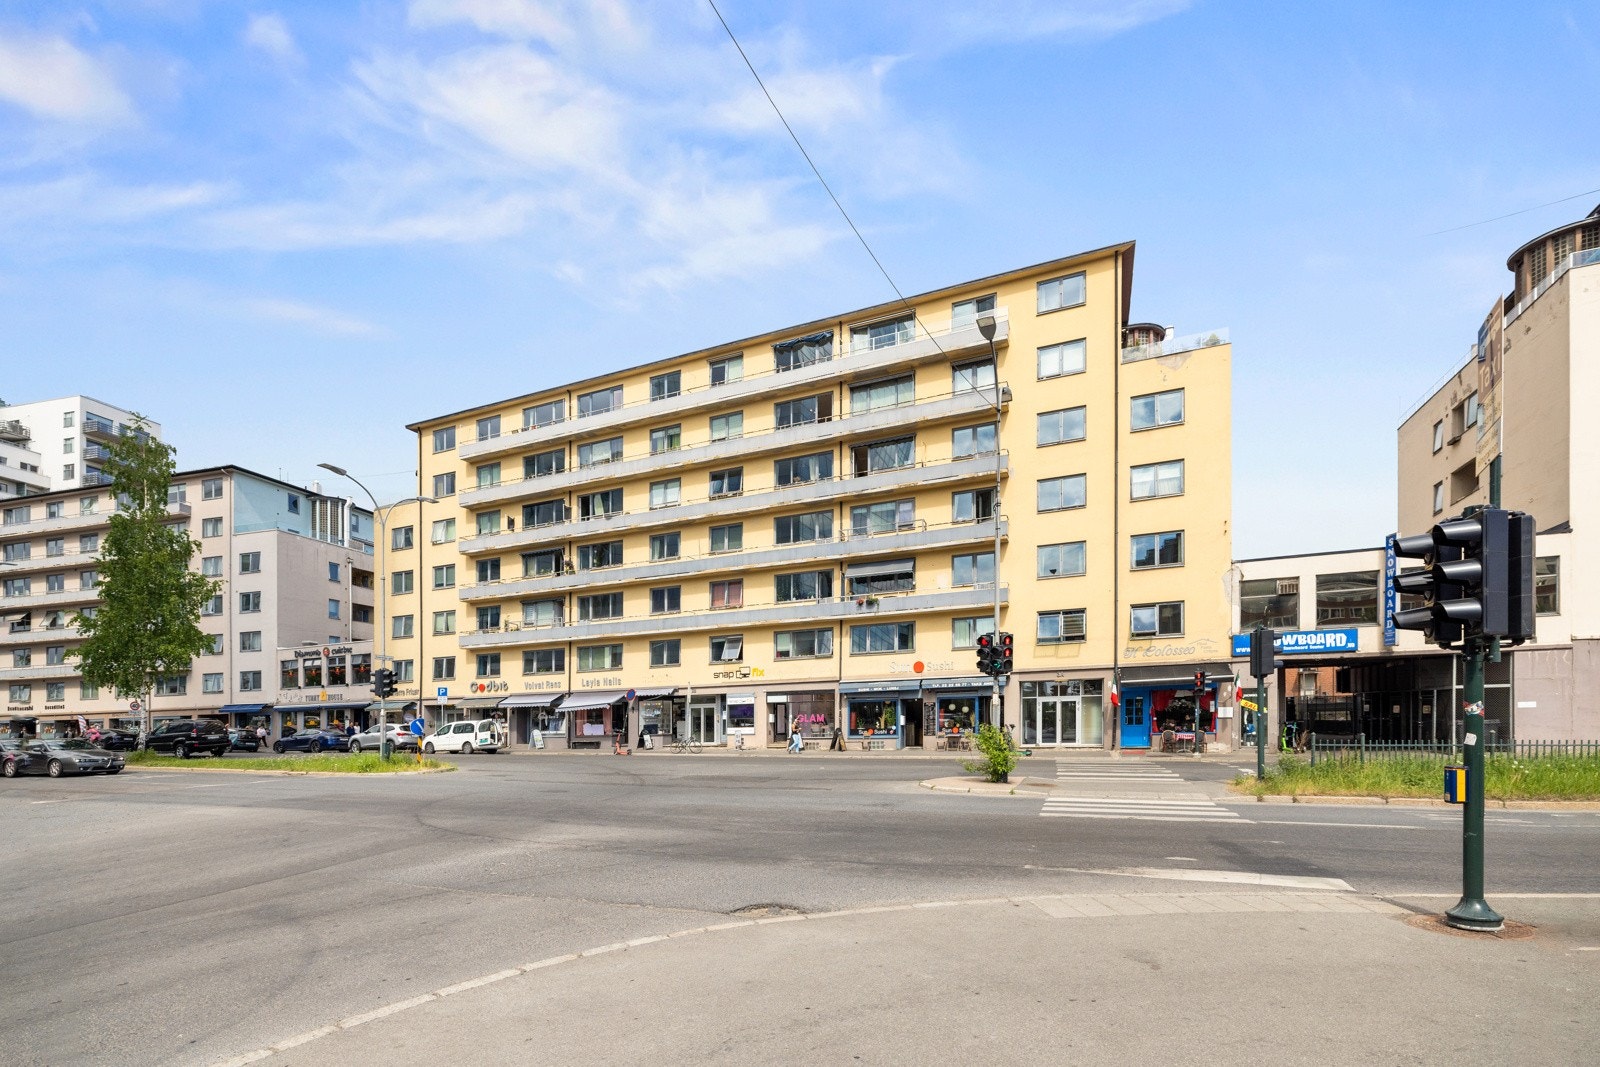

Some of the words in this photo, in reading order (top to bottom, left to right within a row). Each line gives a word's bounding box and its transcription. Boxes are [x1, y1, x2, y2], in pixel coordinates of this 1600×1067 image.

[1480, 343, 1501, 393] Taxi
[1386, 538, 1396, 628] SNOWBOARD
[1273, 633, 1347, 648] OWBOARD
[713, 671, 734, 680] snap
[752, 667, 765, 677] fix
[927, 661, 954, 672] Sushi
[797, 714, 825, 723] GLAM
